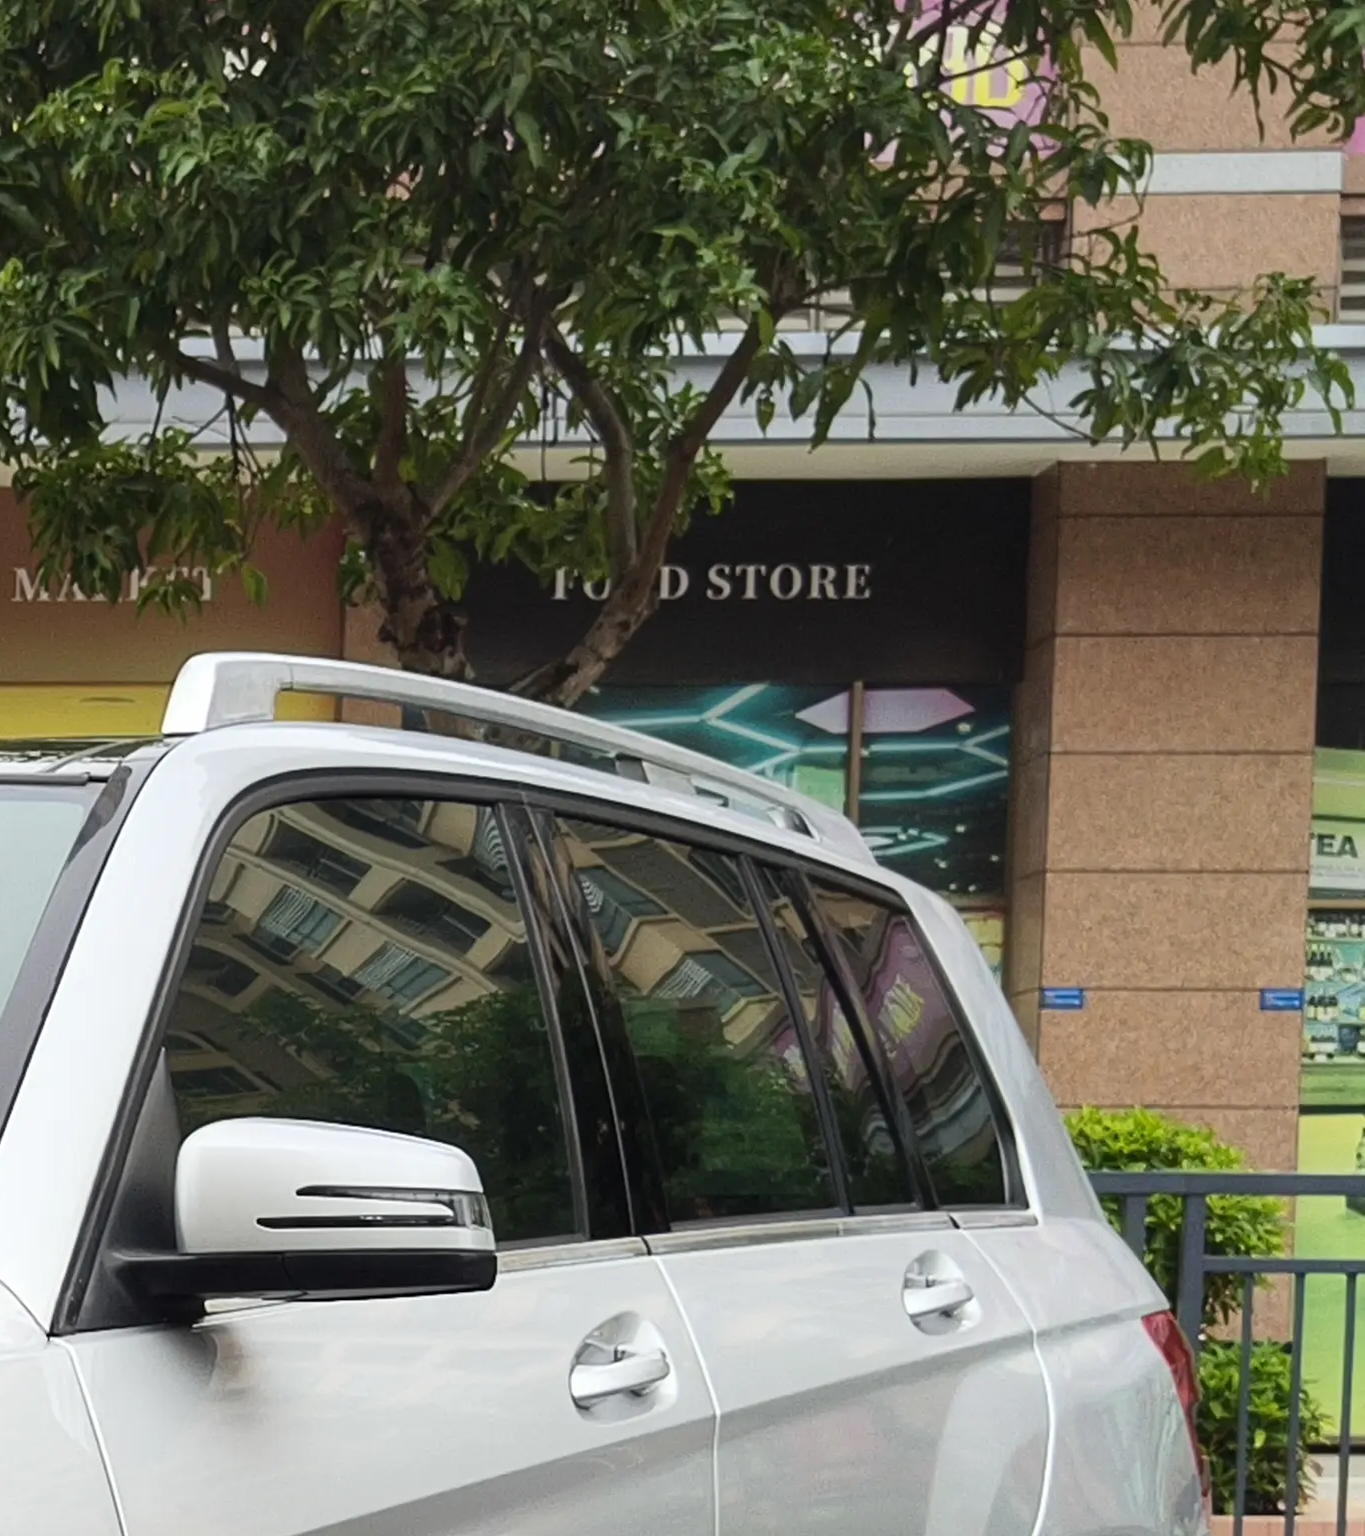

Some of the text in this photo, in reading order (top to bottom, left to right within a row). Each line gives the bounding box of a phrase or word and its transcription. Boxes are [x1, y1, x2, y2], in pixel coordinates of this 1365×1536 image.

[550, 563, 872, 600] FOD STORE
[1310, 833, 1359, 858] EA
